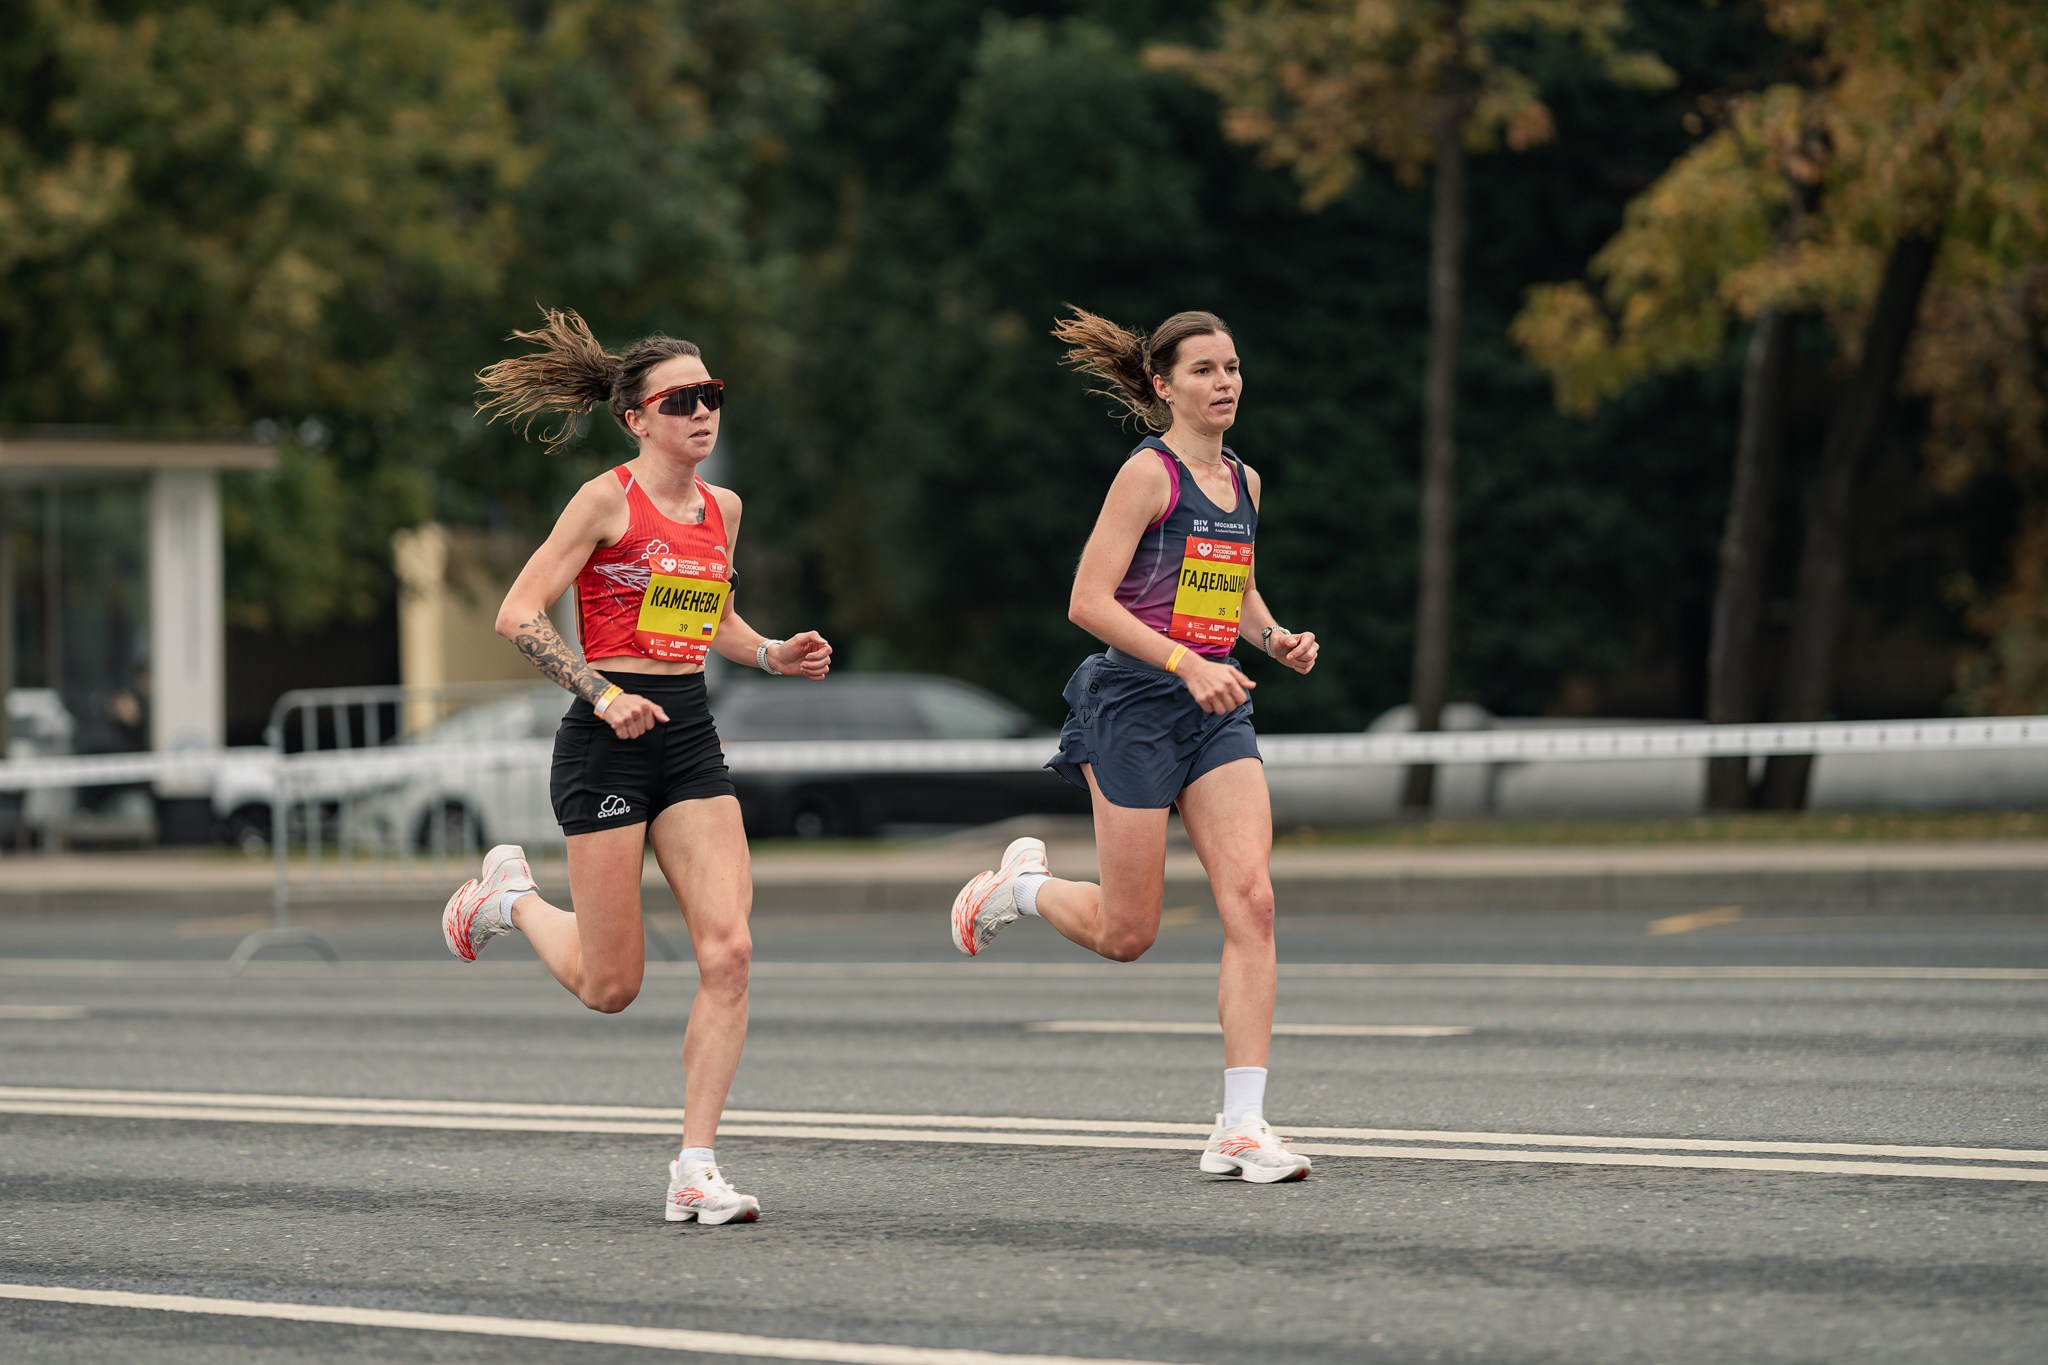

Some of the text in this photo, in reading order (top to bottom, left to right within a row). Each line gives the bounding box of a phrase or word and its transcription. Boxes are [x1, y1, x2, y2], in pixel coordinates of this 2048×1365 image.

[650, 586, 720, 613] КАМЕНЕВА
[1218, 607, 1226, 616] 35
[679, 623, 689, 633] 39
[598, 808, 625, 818] CLOUD
